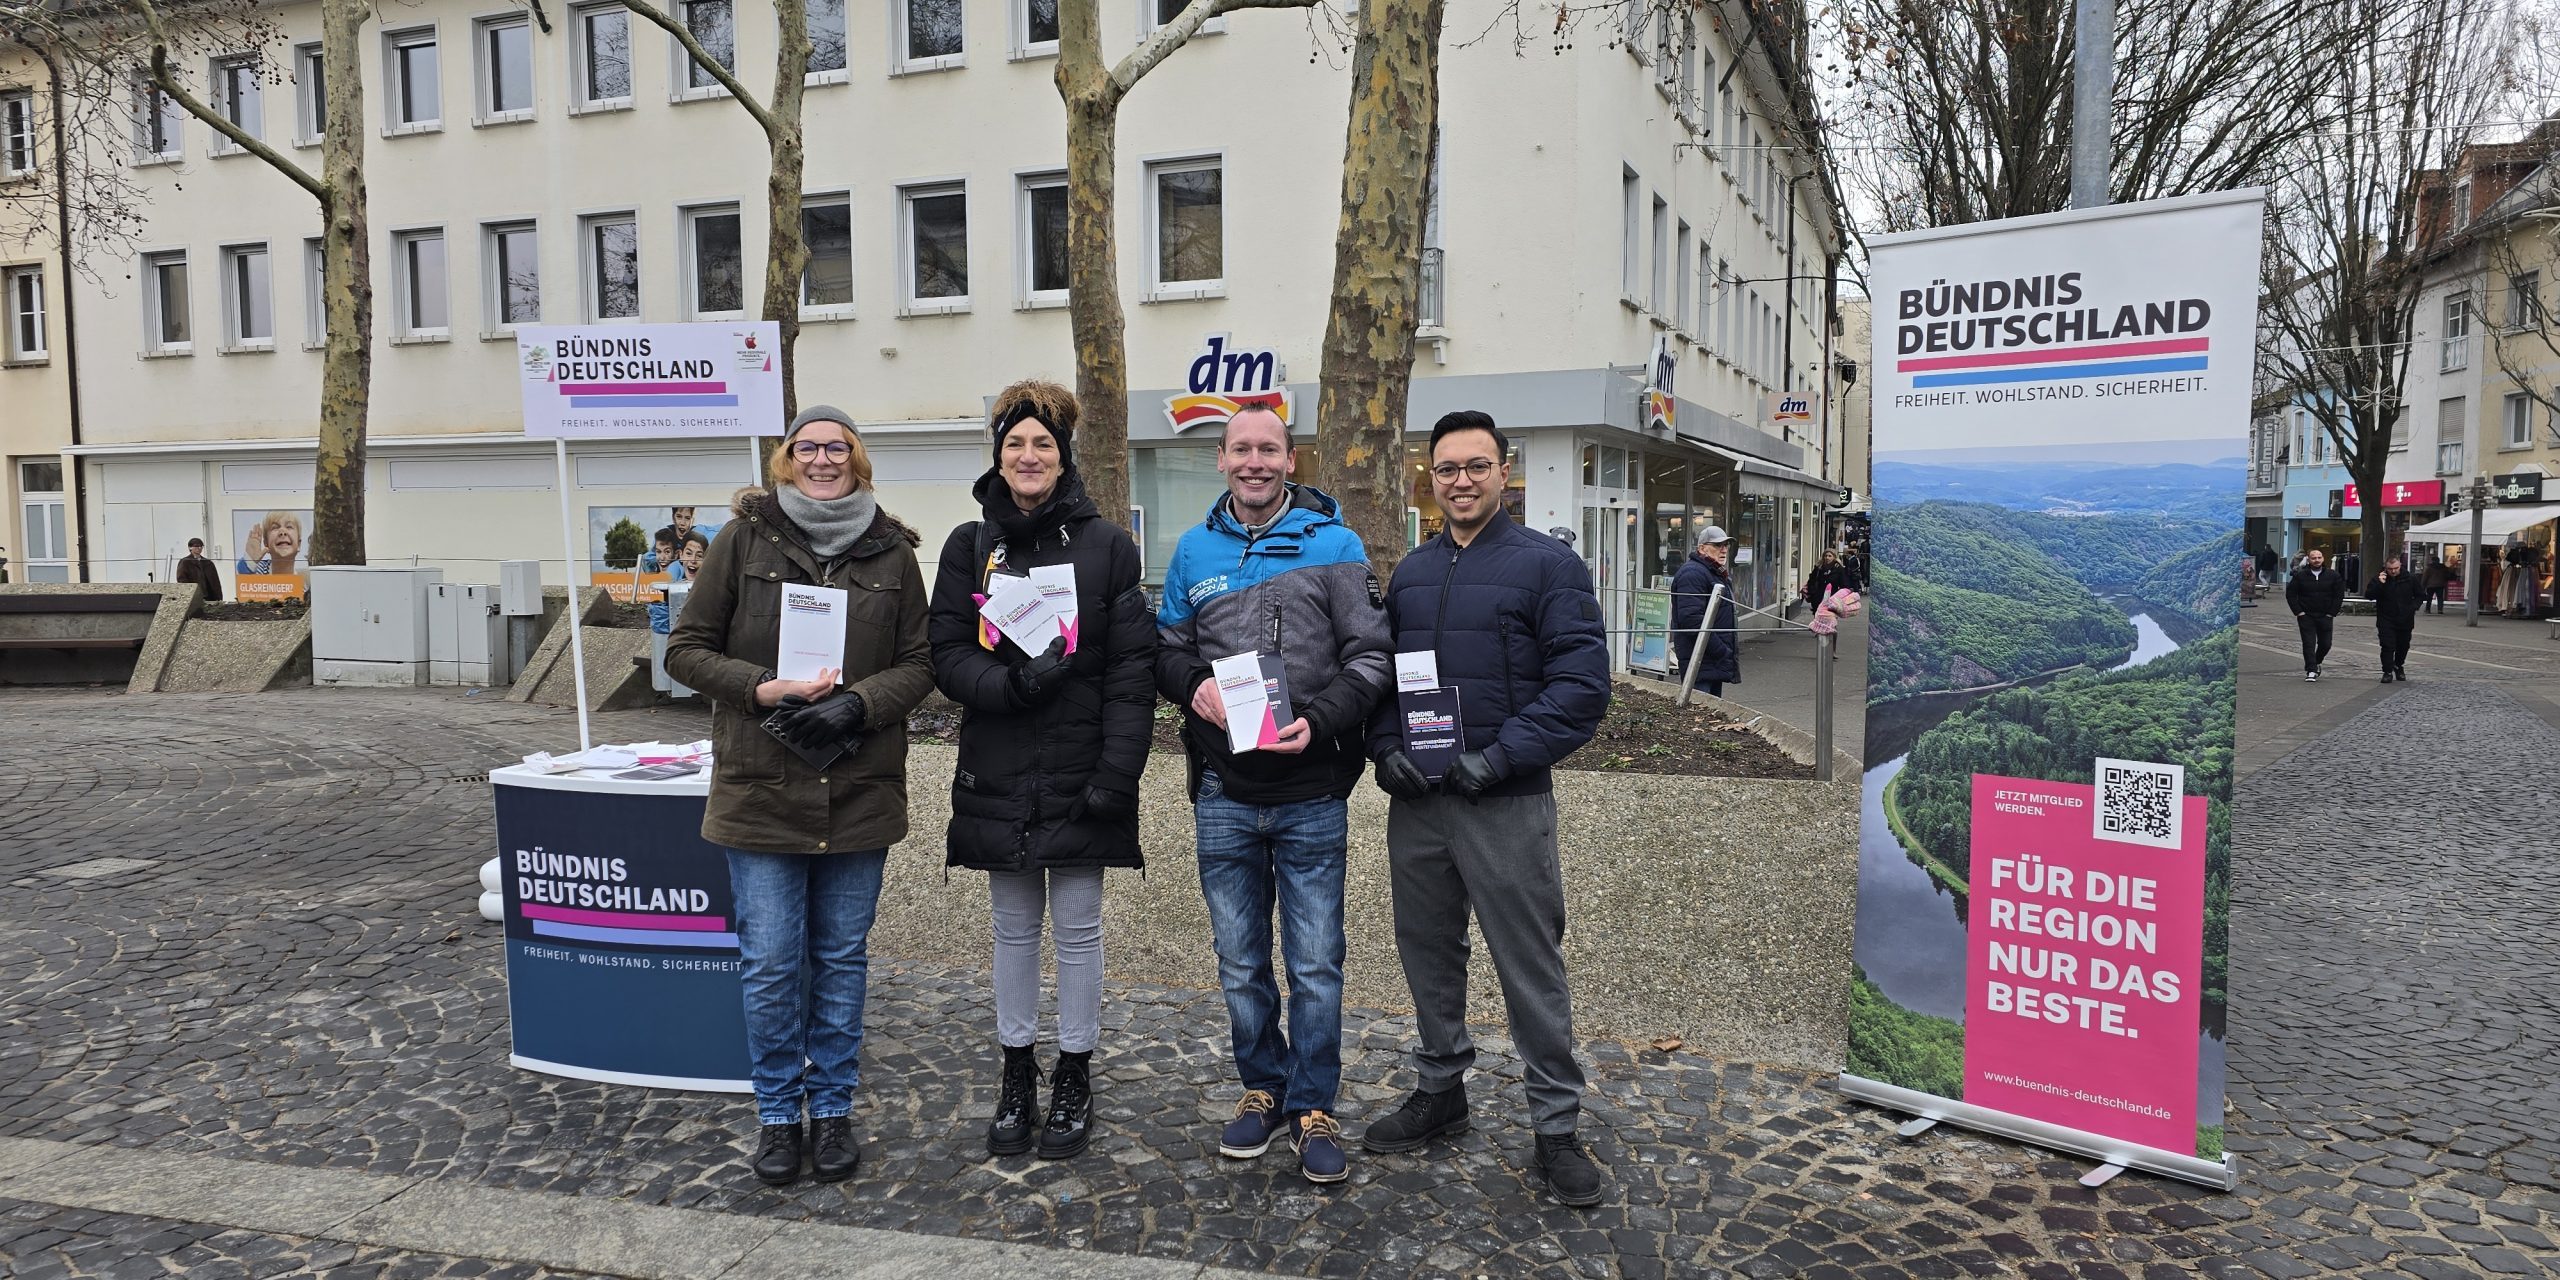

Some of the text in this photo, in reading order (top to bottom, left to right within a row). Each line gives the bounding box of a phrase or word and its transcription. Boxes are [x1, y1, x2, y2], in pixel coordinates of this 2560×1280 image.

[1899, 272, 2082, 320] BÜNDNIS
[1898, 298, 2211, 355] DEUTSCHLAND
[556, 335, 652, 358] BÜNDNIS
[558, 359, 714, 380] DEUTSCHLAND
[1188, 337, 1273, 395] dm
[1657, 337, 1674, 394] dm
[1779, 396, 1807, 412] dm
[1895, 376, 2208, 408] FREIHEIT. WOHLSTAND. SICHERHEIT.
[561, 417, 743, 427] FREIHEIT. WOHLSTAND. SICHERHEIT.
[2259, 422, 2273, 484] dielmann
[240, 582, 294, 593] GLASREINIGER?
[788, 592, 816, 601] BÜNDNIS
[788, 598, 831, 608] DEUTSCHLAND
[1407, 710, 1435, 719] BÜNDNIS
[1408, 715, 1453, 725] DEUTSCHLAND
[1994, 789, 2083, 808] JETZT MITGLIED
[1994, 802, 2046, 817] WERDEN.
[516, 846, 628, 882] BÜNDNIS
[518, 876, 710, 912] DEUTSCHLAND
[1991, 854, 2157, 912] FÜR DIE
[1989, 898, 2157, 954] REGION
[524, 946, 574, 962] FREIHEIT.
[578, 953, 656, 969] WOHLSTAND.
[1988, 941, 2181, 1004] NUR DAS
[1987, 980, 2139, 1039] BESTE.
[1983, 1070, 2171, 1121] www.buendnis-deutschland.de
